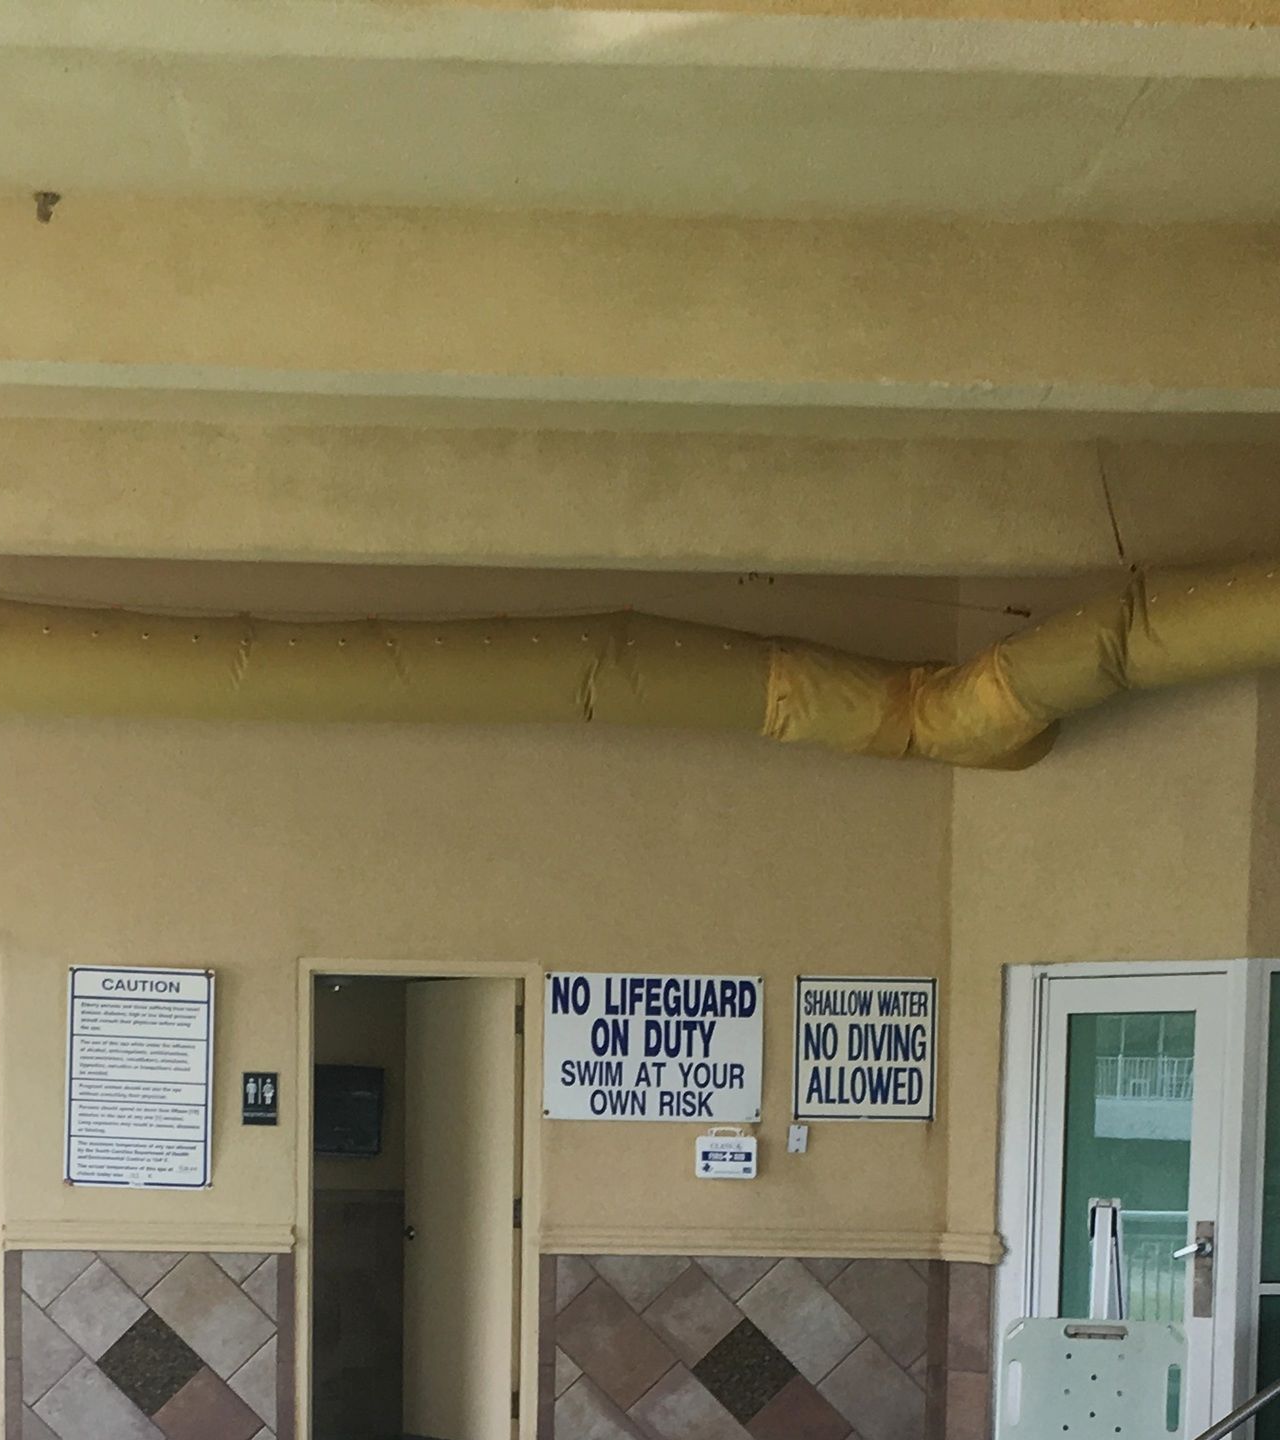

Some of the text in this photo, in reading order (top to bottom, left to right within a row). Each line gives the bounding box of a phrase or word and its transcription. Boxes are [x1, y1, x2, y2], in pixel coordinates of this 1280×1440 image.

[101, 978, 181, 994] CAUTION
[551, 976, 758, 1019] NO LIFEGUARD
[804, 990, 928, 1018] SHALLOW WATER
[590, 1018, 717, 1059] ON DUTY
[804, 1022, 927, 1062] NO DIVING
[561, 1060, 745, 1089] SWIM AT YOUR
[805, 1066, 923, 1105] ALLOWED
[589, 1089, 714, 1118] OWN RISK
